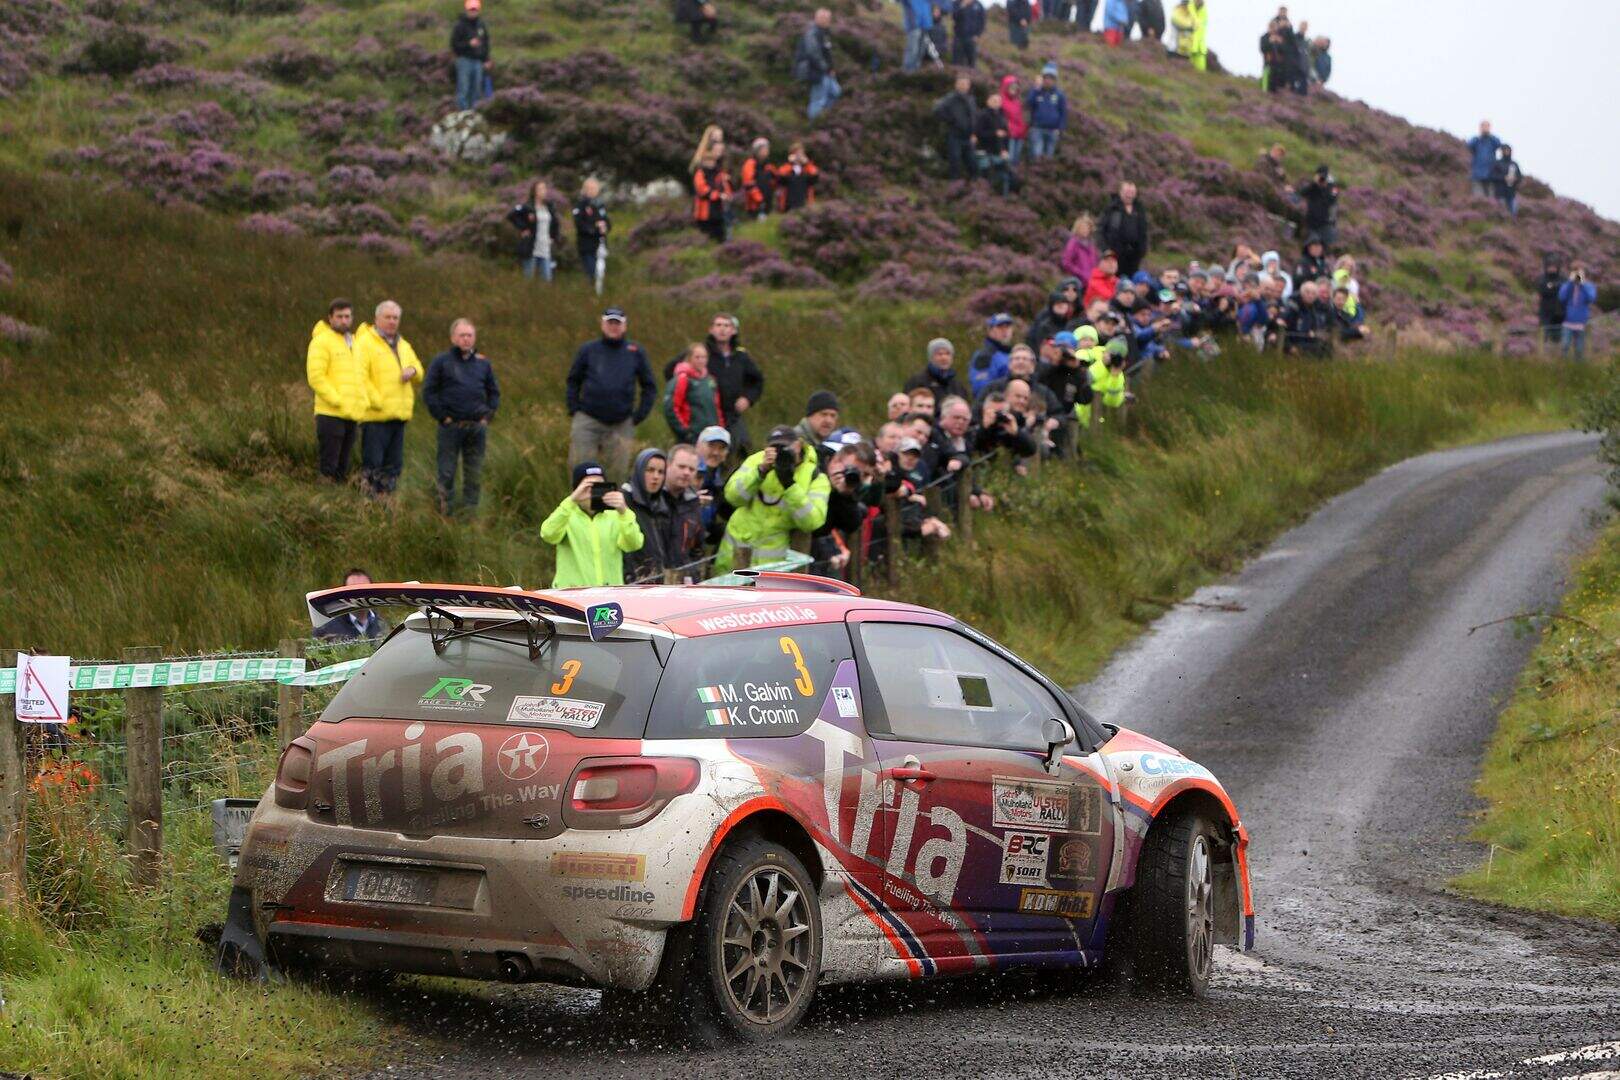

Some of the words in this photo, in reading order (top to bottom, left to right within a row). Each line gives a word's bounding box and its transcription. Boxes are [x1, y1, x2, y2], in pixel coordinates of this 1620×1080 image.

[697, 605, 818, 632] westcorkoil.ie
[779, 636, 815, 696] 3
[551, 659, 582, 696] 3
[718, 683, 743, 703] M.
[744, 682, 793, 702] Galvin
[556, 705, 598, 718] ULSTER
[560, 712, 596, 722] RALLY
[728, 706, 747, 726] K.
[748, 705, 800, 725] Cronin
[316, 721, 484, 828] Tria
[482, 787, 514, 811] The
[518, 782, 561, 804] Way
[1033, 795, 1068, 811] ULSTER
[804, 718, 968, 907] Tria
[1040, 807, 1067, 821] RALLY
[1007, 834, 1048, 855] BRC
[558, 854, 639, 876] PIRELLI
[562, 885, 656, 905] speedline
[884, 880, 920, 912] Fuelling
[921, 897, 937, 917] The
[938, 909, 959, 929] Way
